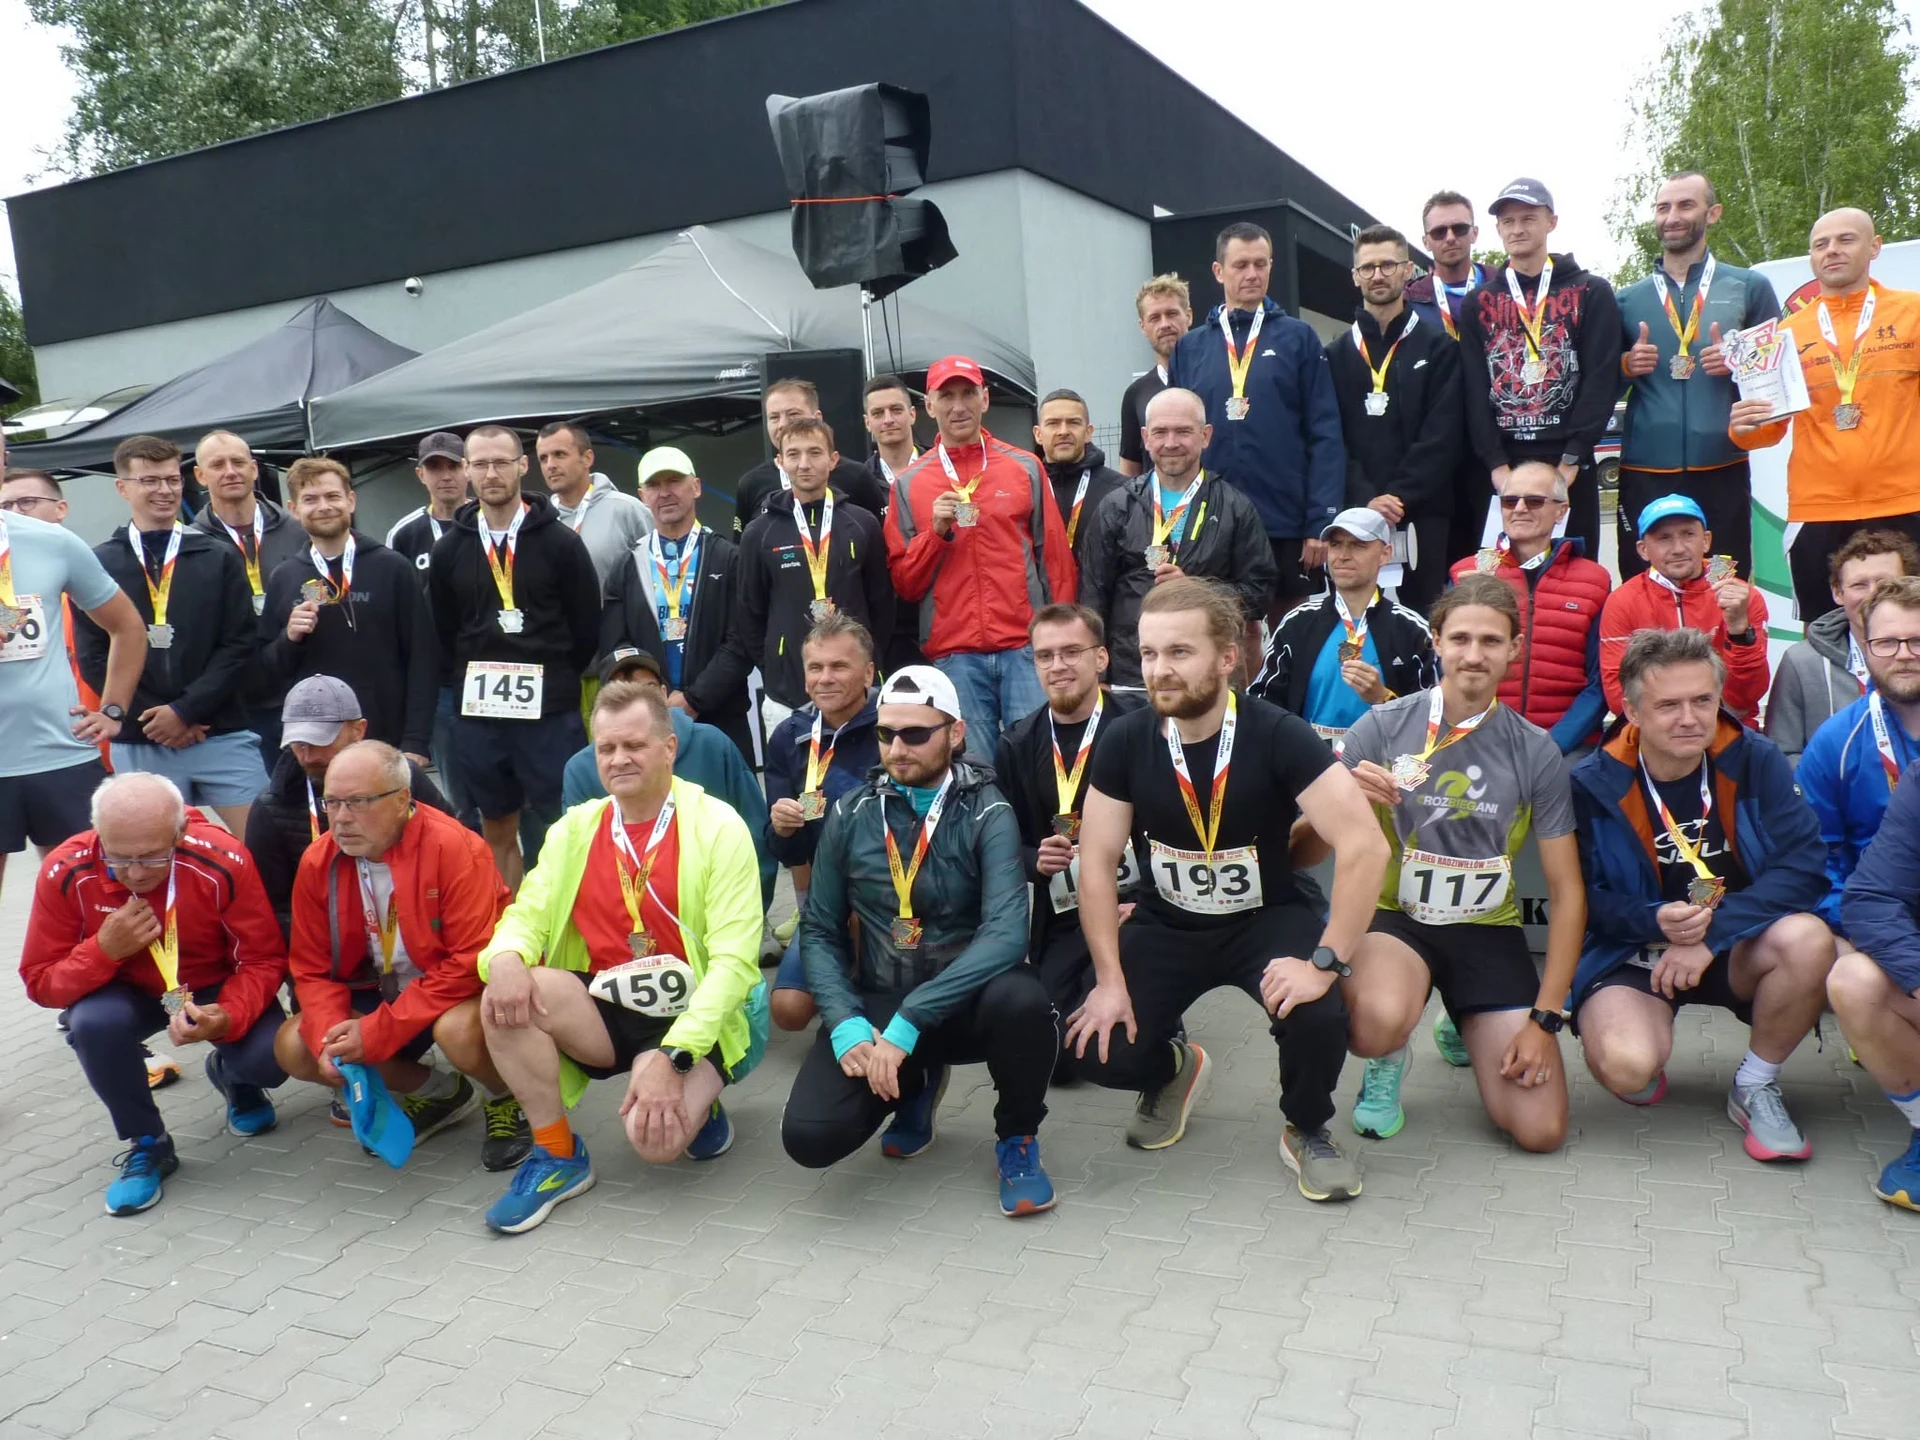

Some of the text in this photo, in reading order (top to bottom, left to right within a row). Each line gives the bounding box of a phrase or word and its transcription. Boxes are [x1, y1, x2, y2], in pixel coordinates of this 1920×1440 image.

[1516, 414, 1560, 427] MOINES
[474, 674, 534, 703] 145
[1164, 846, 1176, 856] BIEG
[1420, 853, 1436, 864] BIEG
[1437, 856, 1486, 869] RADZIWIŁŁÓW
[1161, 862, 1251, 896] 193
[1413, 868, 1502, 907] 117
[601, 969, 688, 1007] 159
